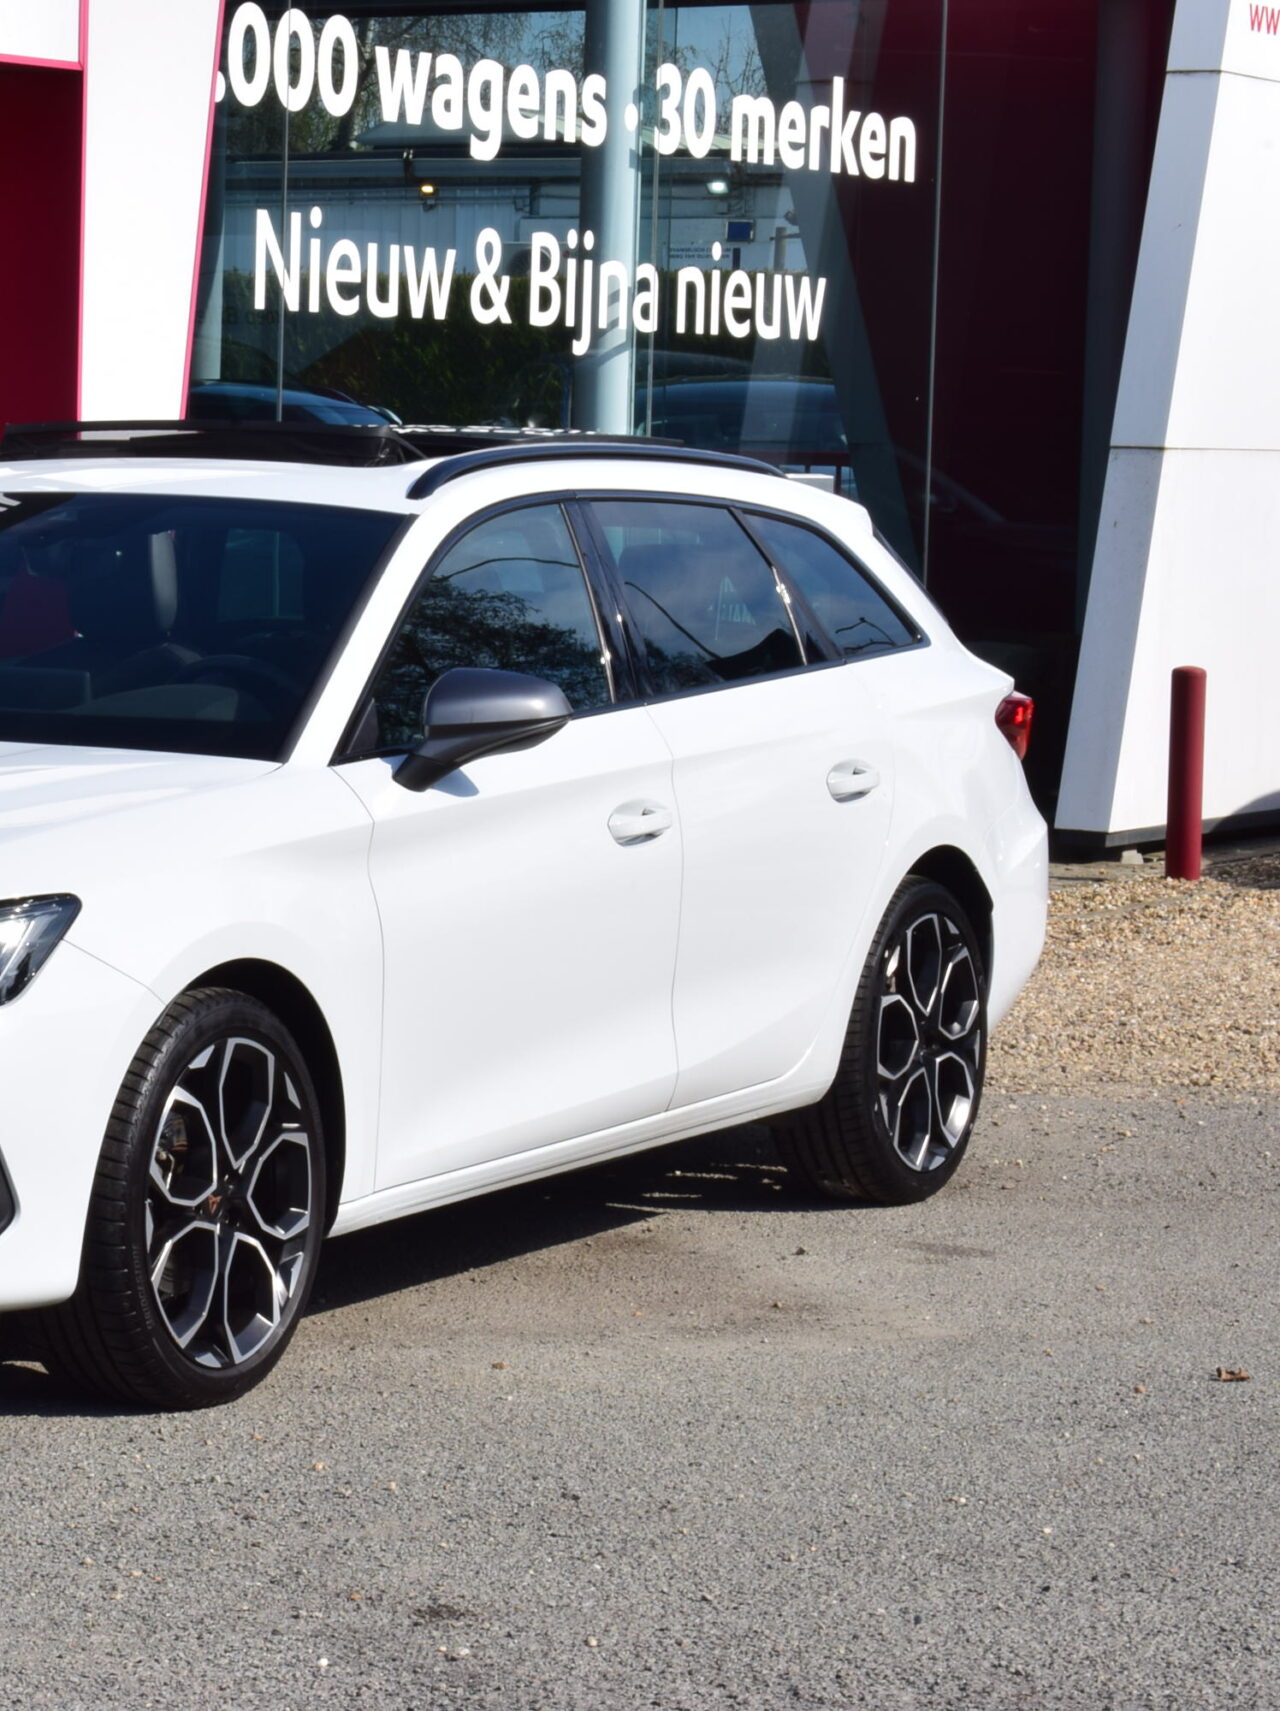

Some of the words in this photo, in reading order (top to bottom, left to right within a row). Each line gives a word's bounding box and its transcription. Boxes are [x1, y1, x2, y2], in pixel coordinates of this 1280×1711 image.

[375, 45, 607, 162] wagens
[654, 62, 716, 159] 30
[730, 76, 917, 183] merken
[253, 206, 457, 320] Nieuw
[469, 227, 513, 324] &
[529, 229, 658, 356] Bijna
[676, 241, 827, 341] nieuw
